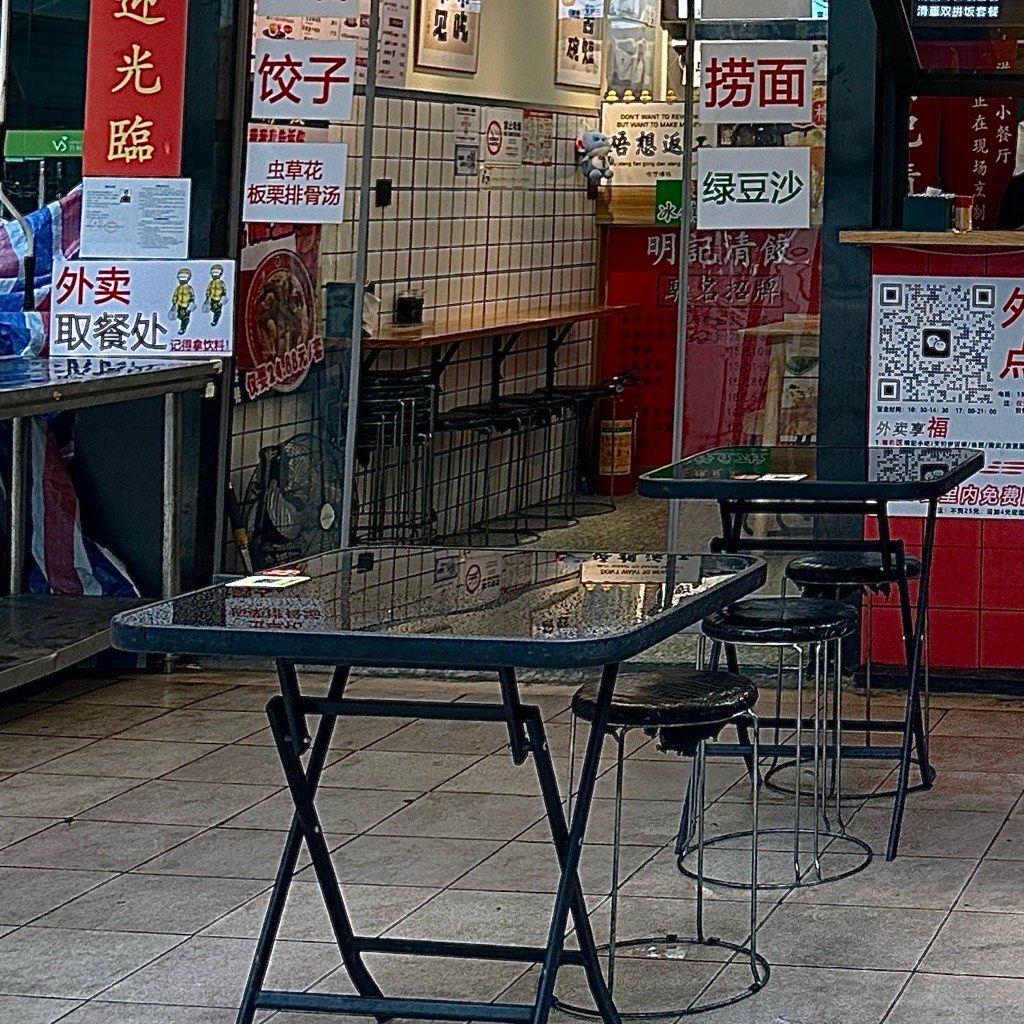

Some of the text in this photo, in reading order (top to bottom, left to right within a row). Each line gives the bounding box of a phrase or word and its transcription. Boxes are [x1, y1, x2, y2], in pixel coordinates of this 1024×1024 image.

[258, 54, 350, 104] 饺子
[704, 57, 808, 108] 捞面
[267, 160, 324, 180] 虫草花
[702, 170, 804, 205] 绿豆沙
[248, 184, 341, 205] 板栗排骨汤
[56, 266, 131, 305] 外卖
[55, 312, 168, 352] 取餐处
[875, 416, 951, 439] 外卖享福
